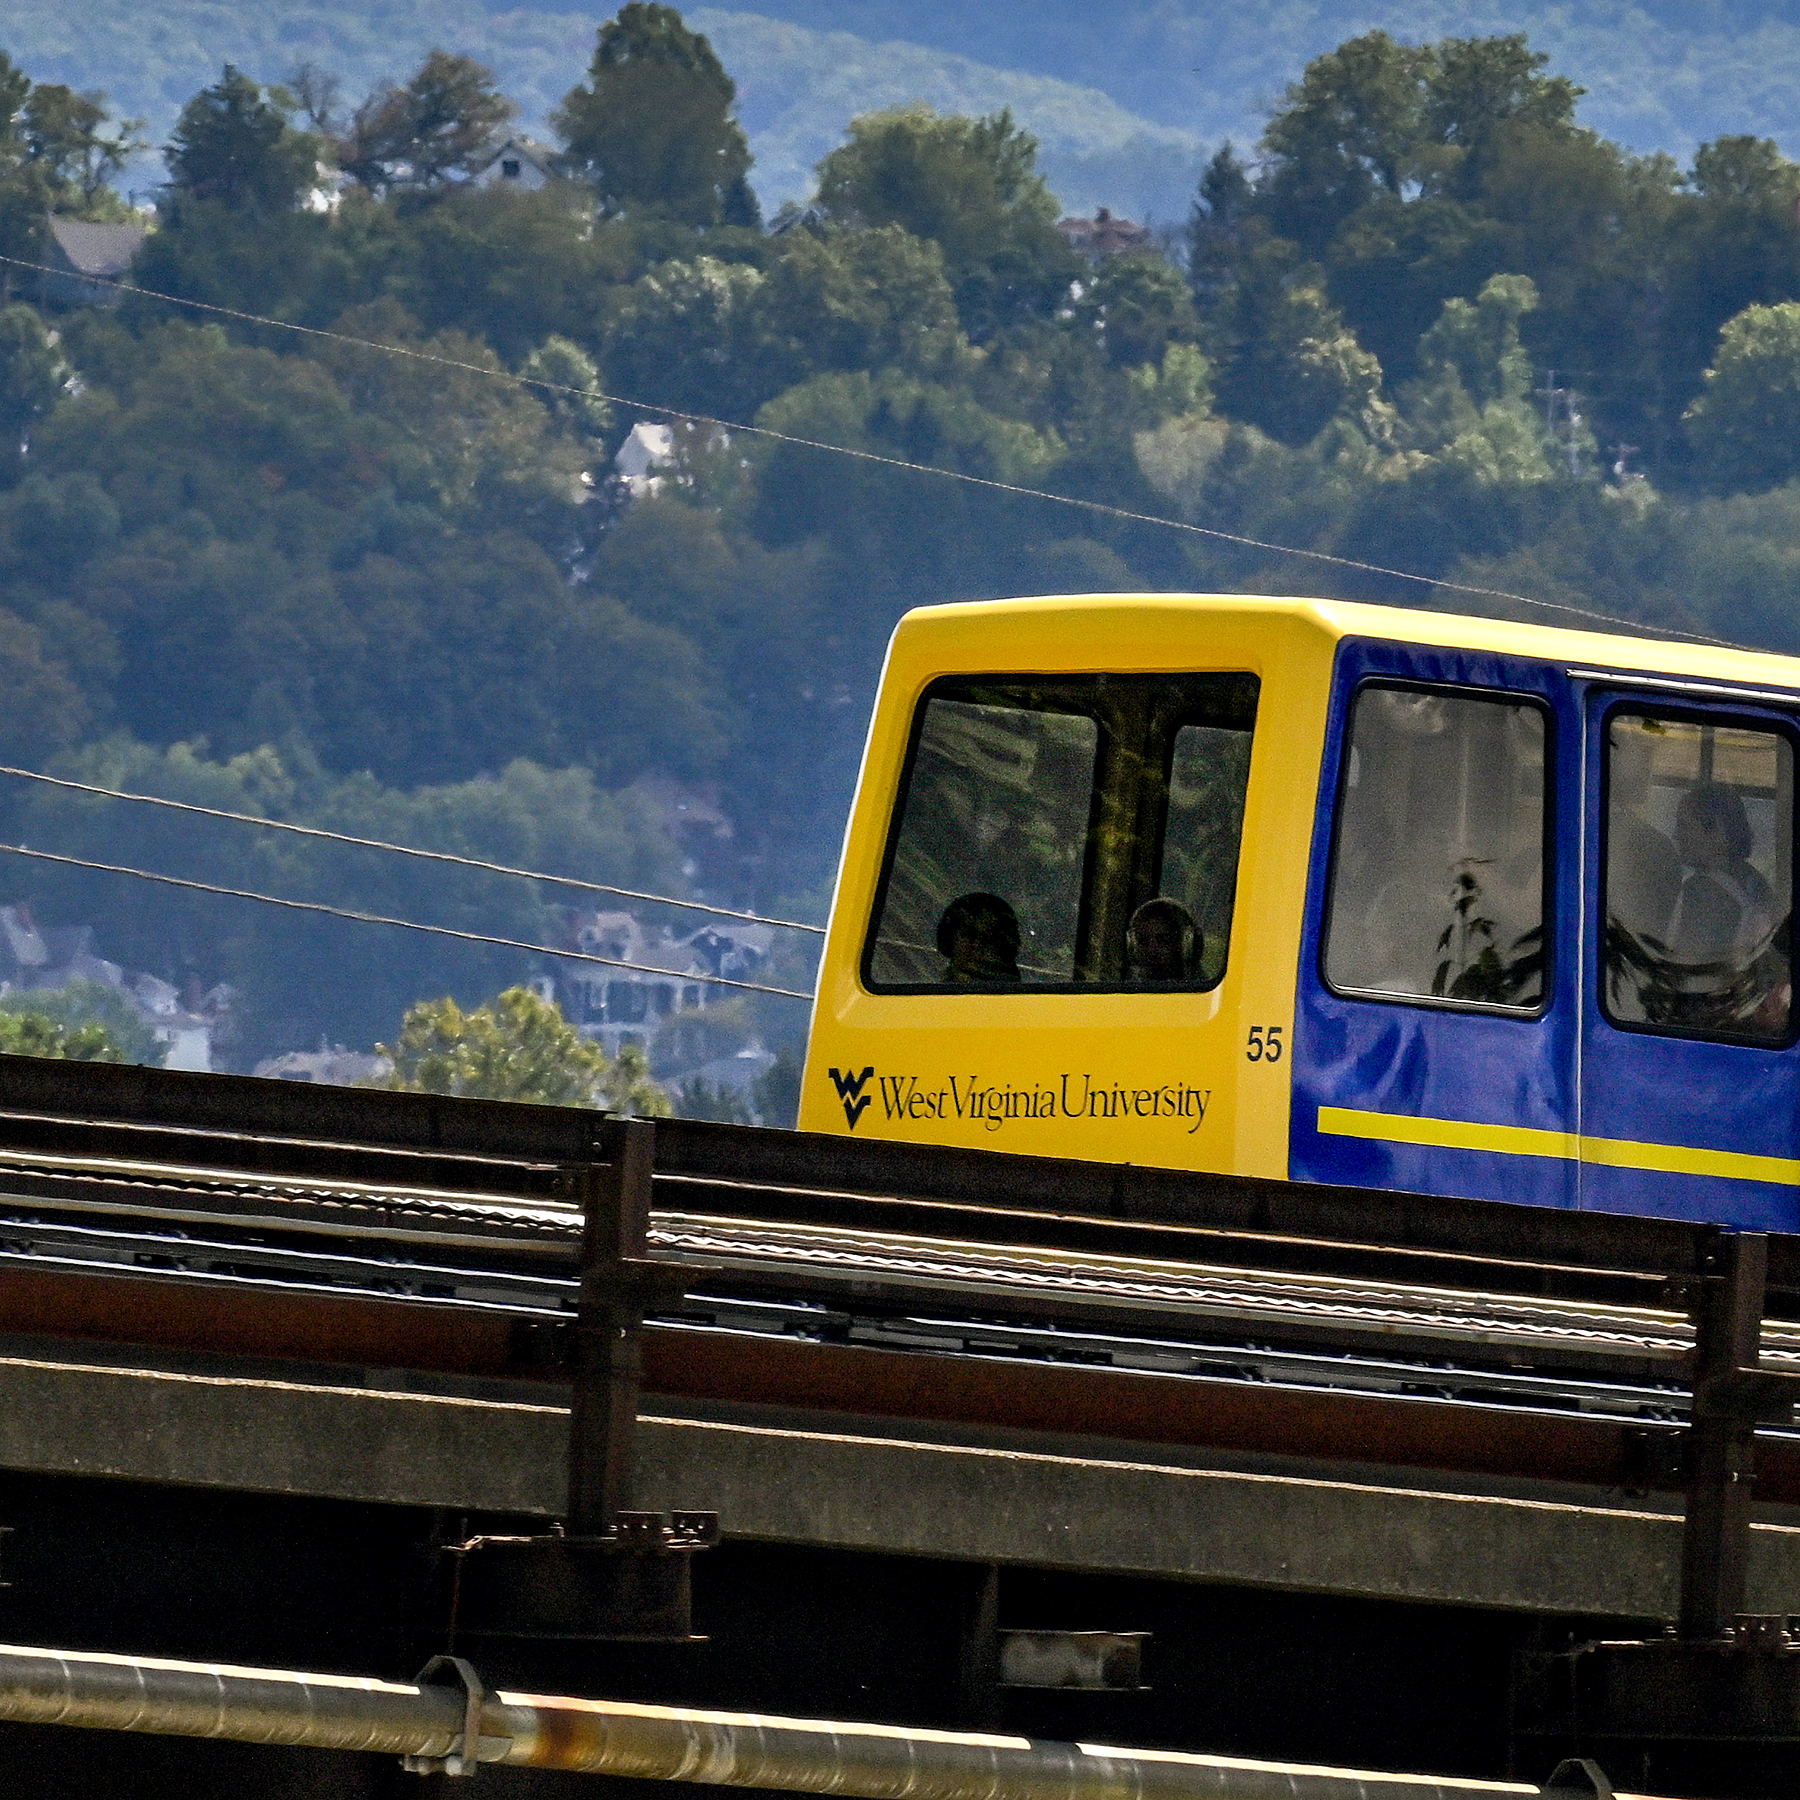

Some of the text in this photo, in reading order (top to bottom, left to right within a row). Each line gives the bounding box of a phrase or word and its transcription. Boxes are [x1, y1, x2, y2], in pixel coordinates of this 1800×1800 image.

[1246, 1026, 1282, 1061] 55
[878, 1073, 1210, 1133] West Virginia University
